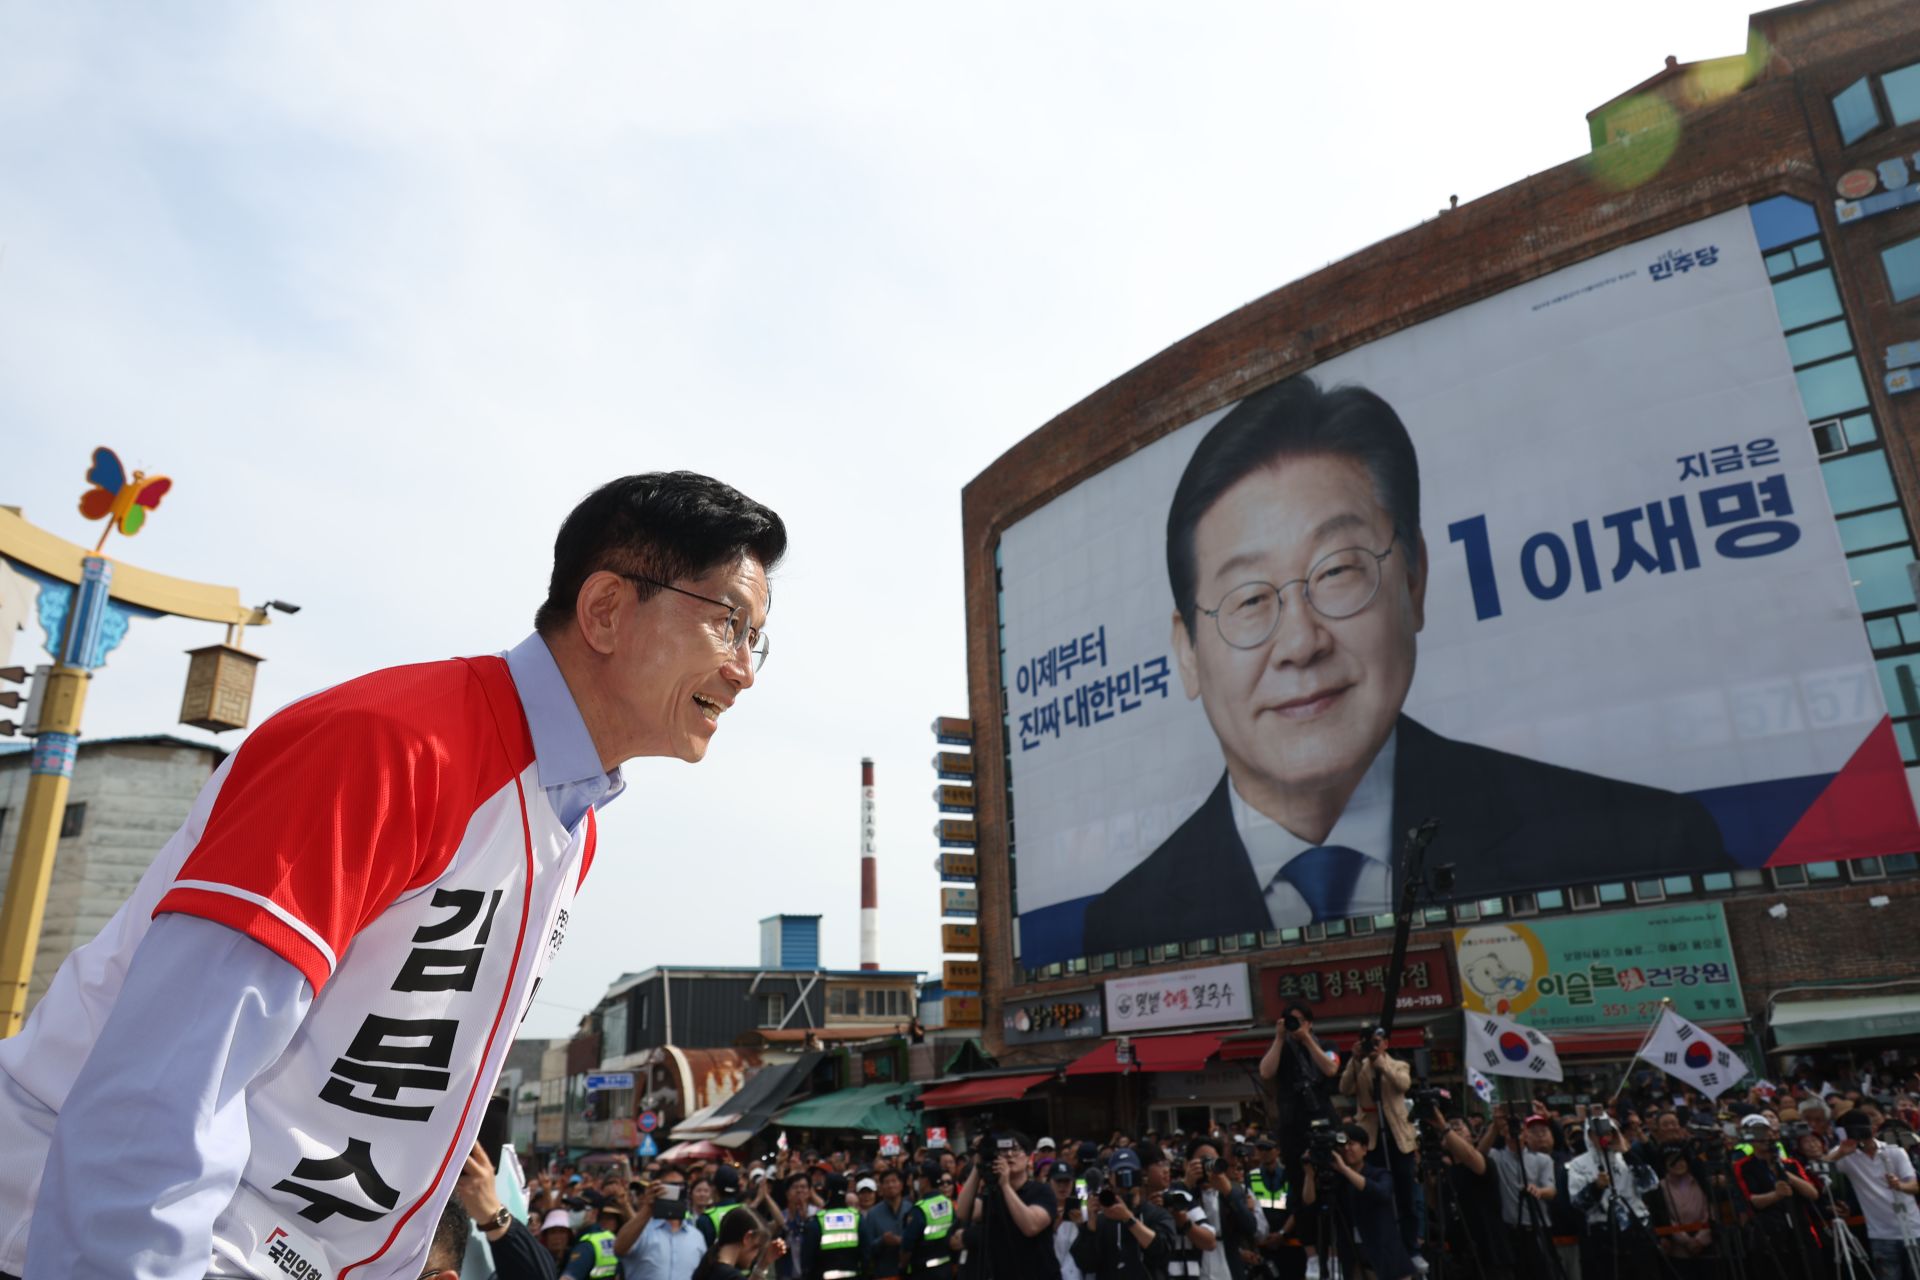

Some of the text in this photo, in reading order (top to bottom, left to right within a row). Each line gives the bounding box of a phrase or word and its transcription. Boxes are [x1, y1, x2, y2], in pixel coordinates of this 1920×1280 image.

[1648, 245, 1720, 282] 민주당
[1676, 437, 1781, 482] 지금은
[1447, 473, 1802, 622] 1 이재명
[1016, 624, 1107, 697] 이제부터
[1018, 655, 1171, 752] 진짜 대한민국
[1192, 982, 1235, 1010] 칼국수
[1281, 961, 1429, 1001] 초원 정육백점
[1537, 964, 1618, 1005] 이슬로
[1647, 962, 1731, 988] 건강원
[271, 888, 504, 1224] 김문수
